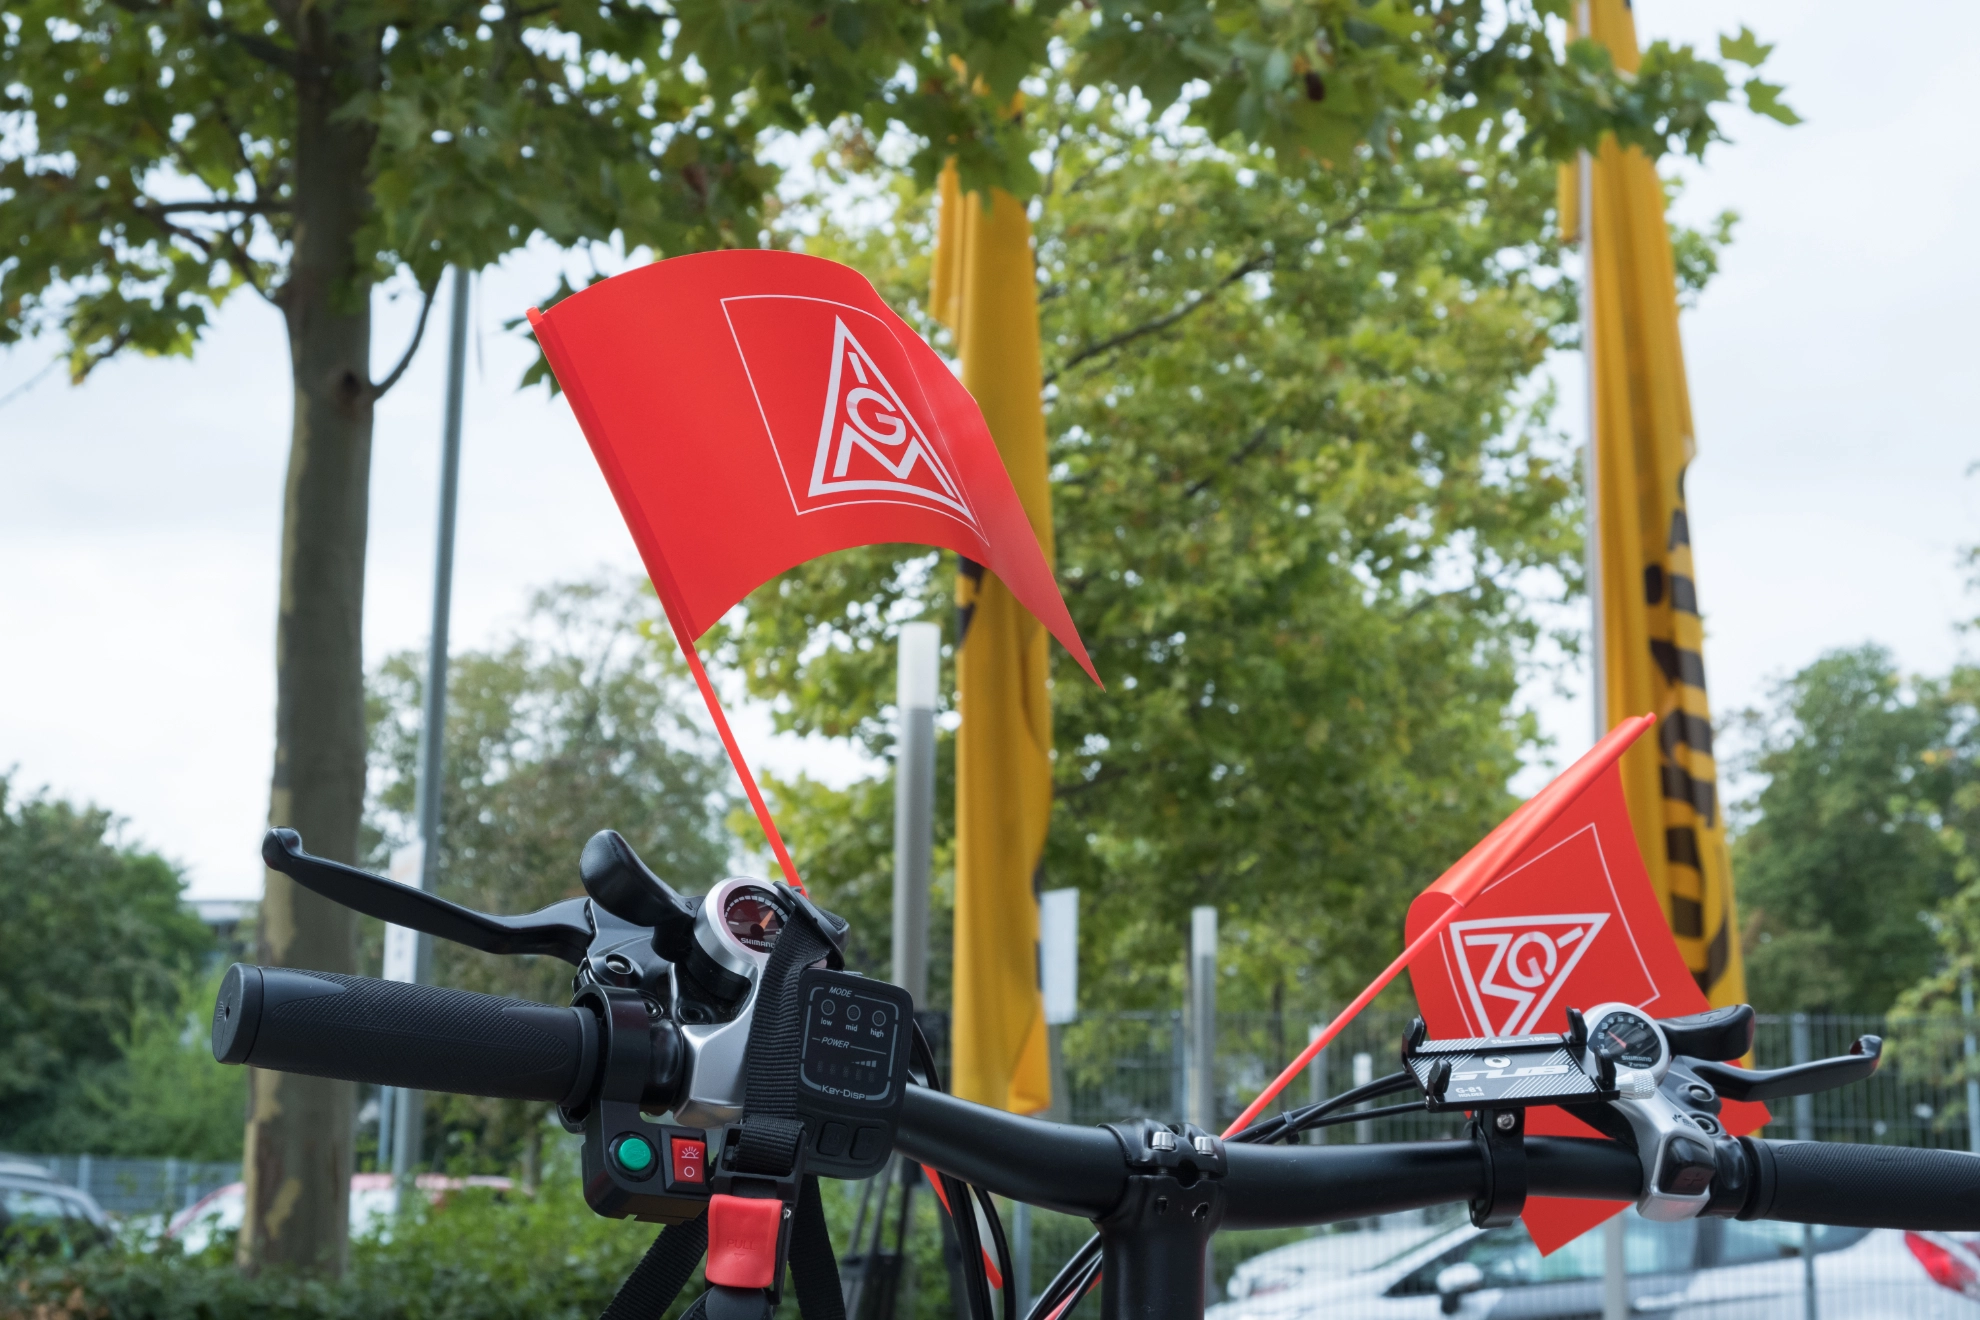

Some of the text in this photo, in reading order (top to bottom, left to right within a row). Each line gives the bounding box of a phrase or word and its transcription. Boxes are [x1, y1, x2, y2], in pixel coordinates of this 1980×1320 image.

[828, 986, 853, 998] MODE
[820, 1016, 885, 1038] low mid high
[1597, 1032, 1605, 1040] 2
[1601, 1022, 1609, 1030] 3
[1627, 1016, 1635, 1024] 6
[1637, 1022, 1644, 1030] 7
[821, 1036, 850, 1049] POWER
[1621, 1055, 1653, 1063] SHIMANO
[1455, 1086, 1483, 1094] G-81
[726, 1238, 757, 1252] PULL
